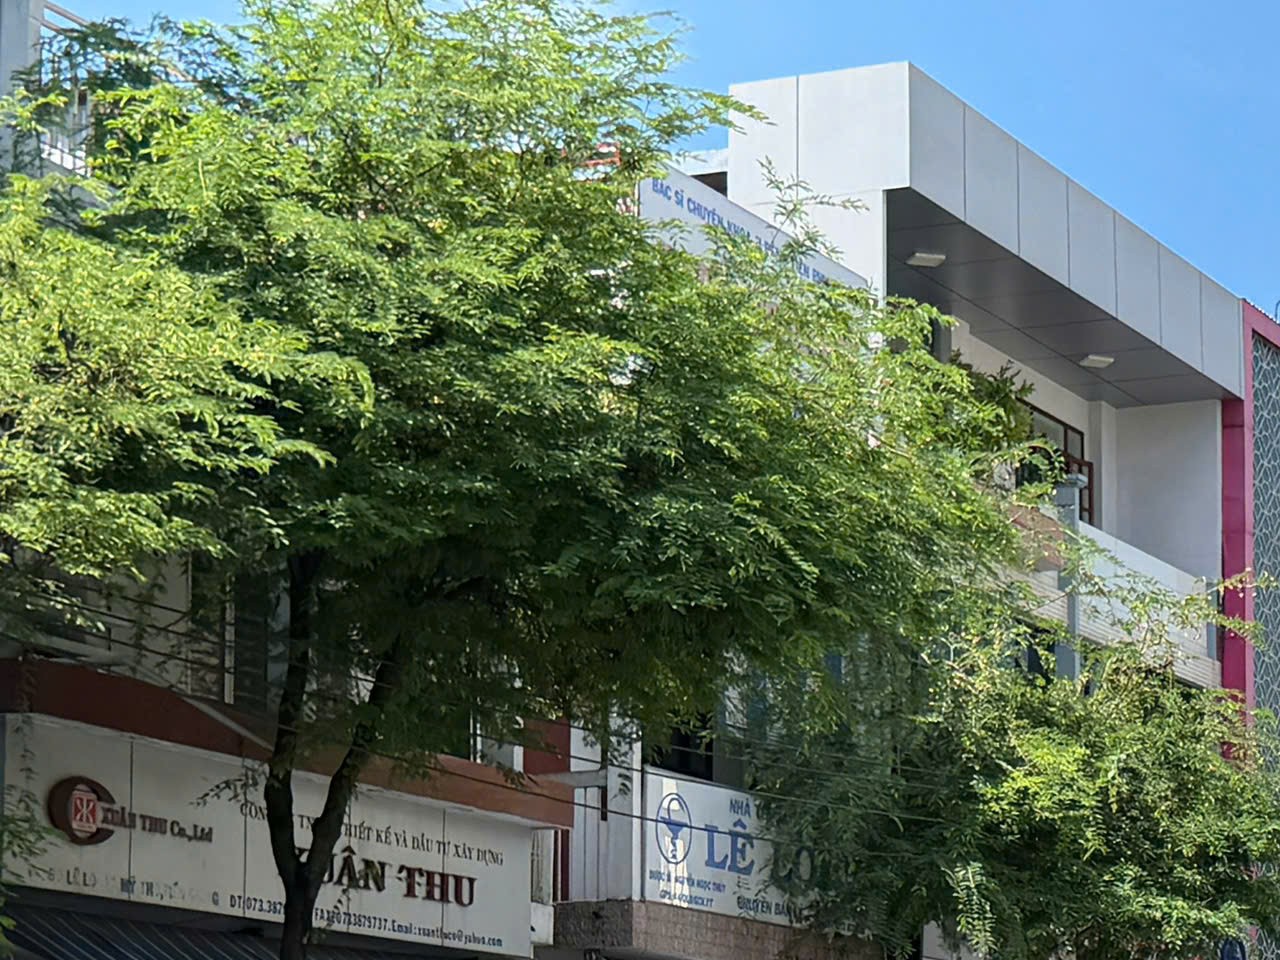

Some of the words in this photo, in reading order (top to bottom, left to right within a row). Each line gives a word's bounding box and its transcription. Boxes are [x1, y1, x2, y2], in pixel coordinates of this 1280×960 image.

[139, 814, 168, 835] THU
[240, 802, 267, 821] CÔN
[376, 826, 393, 846] KẾ
[393, 830, 409, 849] VÀ
[705, 818, 755, 876] LÊ
[397, 863, 478, 907] THU
